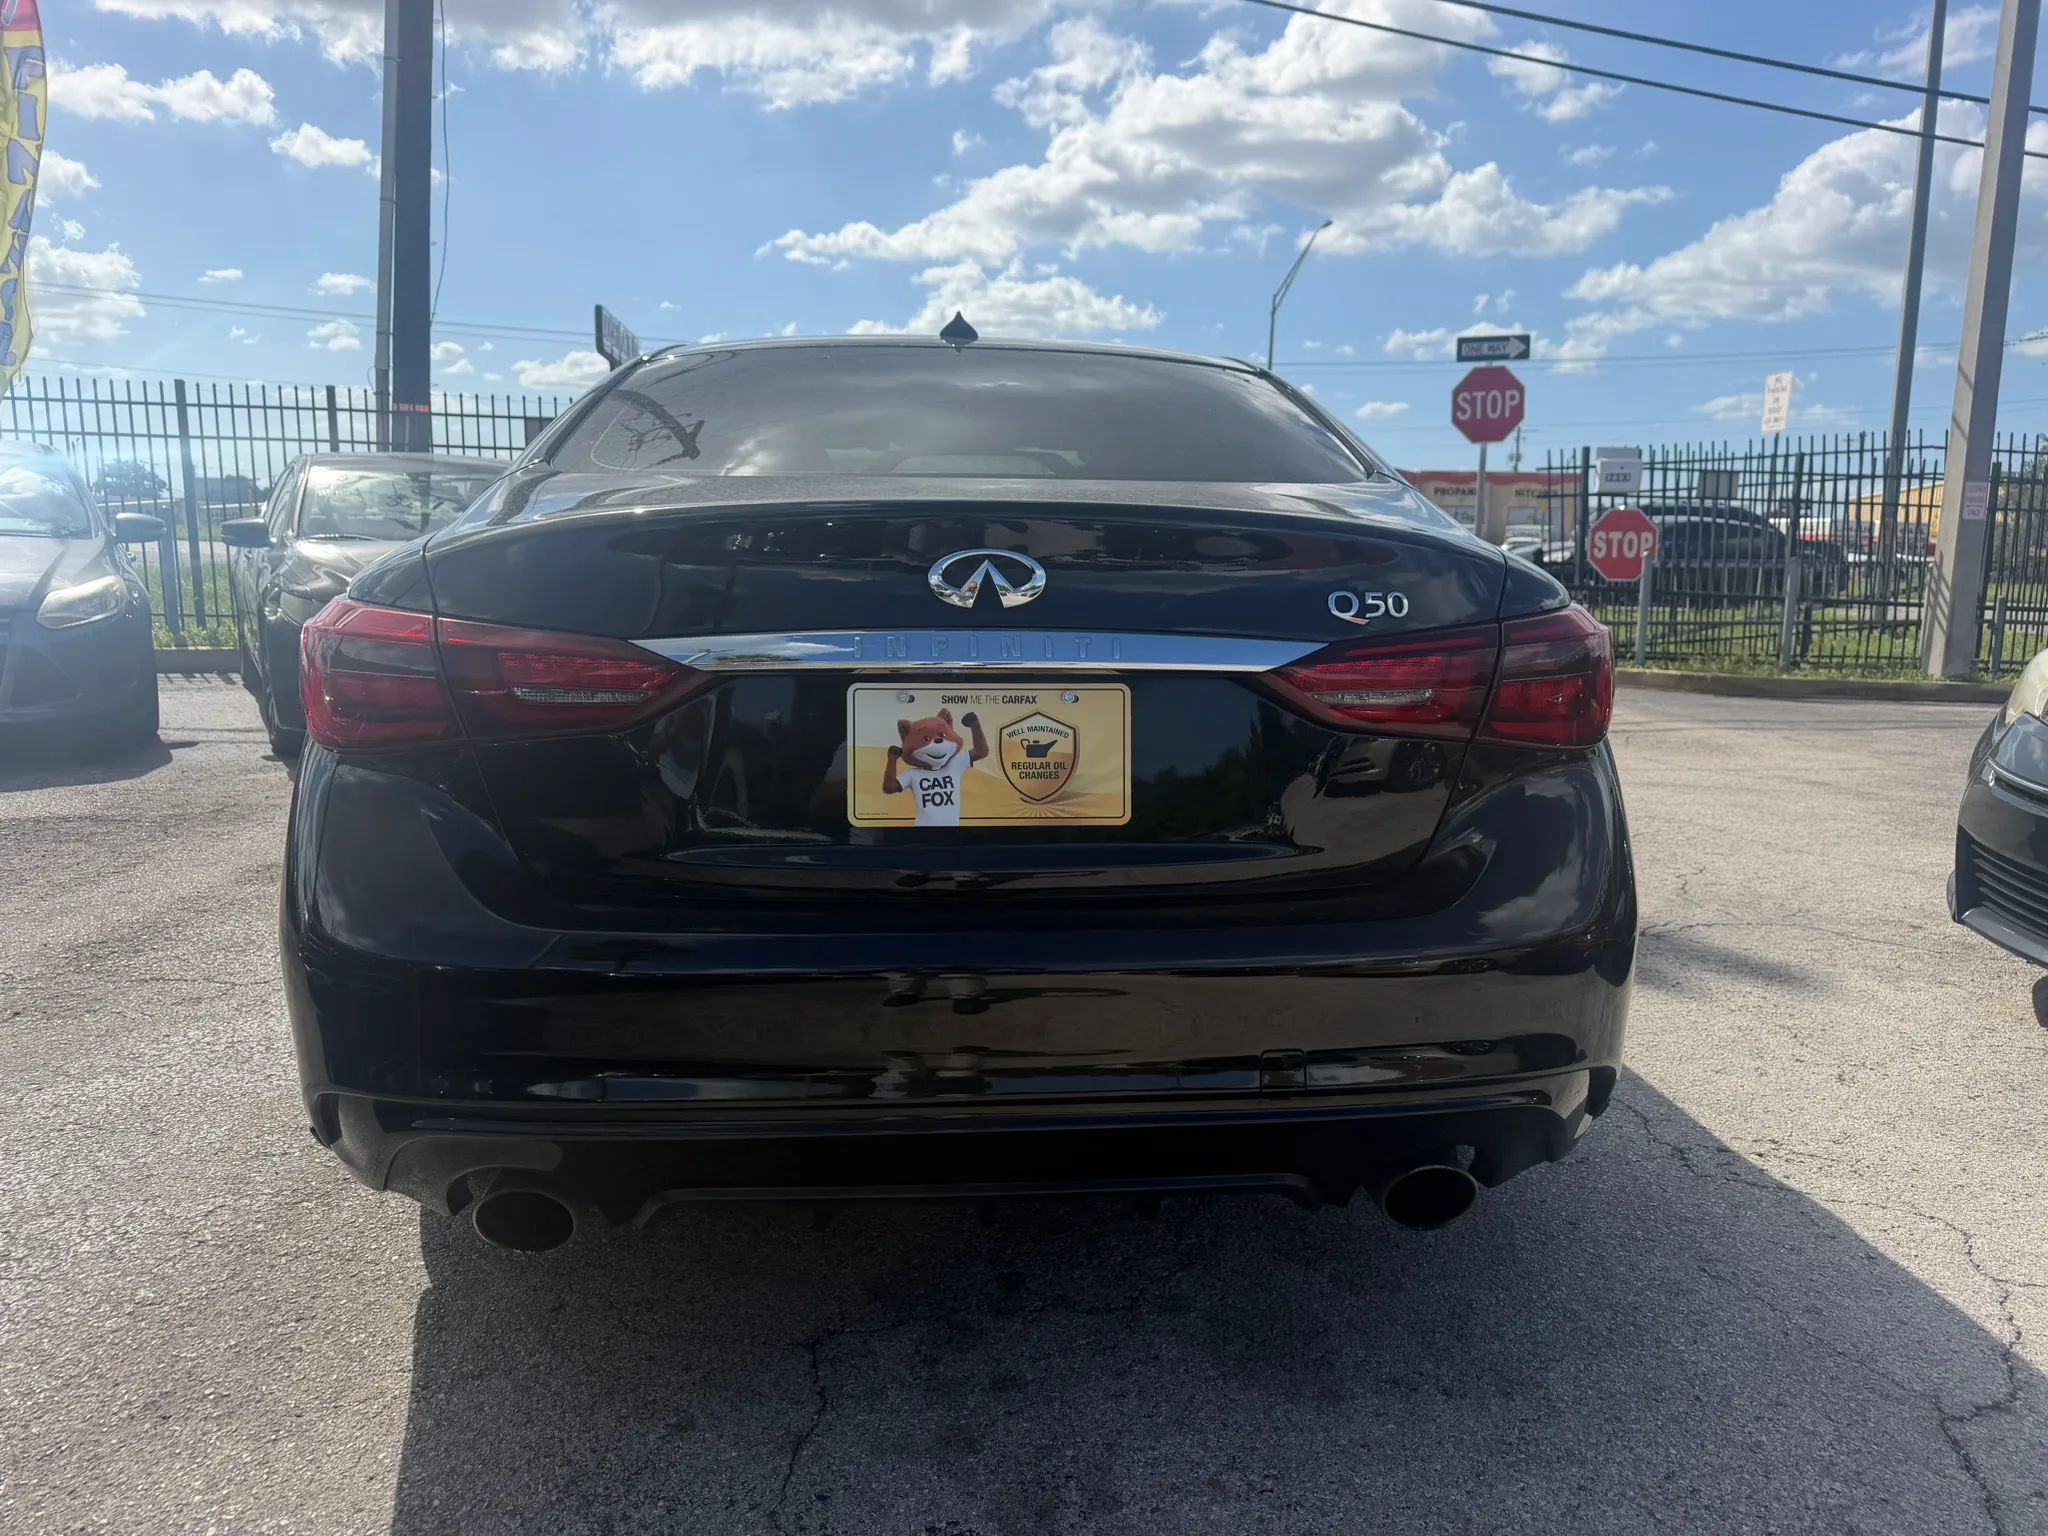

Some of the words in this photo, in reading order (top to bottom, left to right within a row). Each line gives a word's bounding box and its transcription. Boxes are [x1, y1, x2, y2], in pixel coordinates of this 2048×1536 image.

[1487, 343, 1507, 353] WAY
[1456, 389, 1521, 421] STOP
[1433, 487, 1478, 497] PROPAN
[1592, 530, 1654, 560] STOP
[1327, 590, 1409, 625] Q50
[853, 635, 1121, 660] INFINITI
[941, 694, 969, 705] SHOW
[970, 694, 984, 705] ME
[984, 694, 1000, 705] THE
[1001, 694, 1037, 705] CARFAX
[1006, 727, 1027, 739] WELL
[1026, 725, 1070, 740] MAINTAINED
[1011, 761, 1051, 771] REGULAR
[1052, 761, 1068, 771] OIL
[919, 775, 955, 792] CAR
[1018, 770, 1060, 781] CHANGES
[921, 790, 955, 809] FOX
